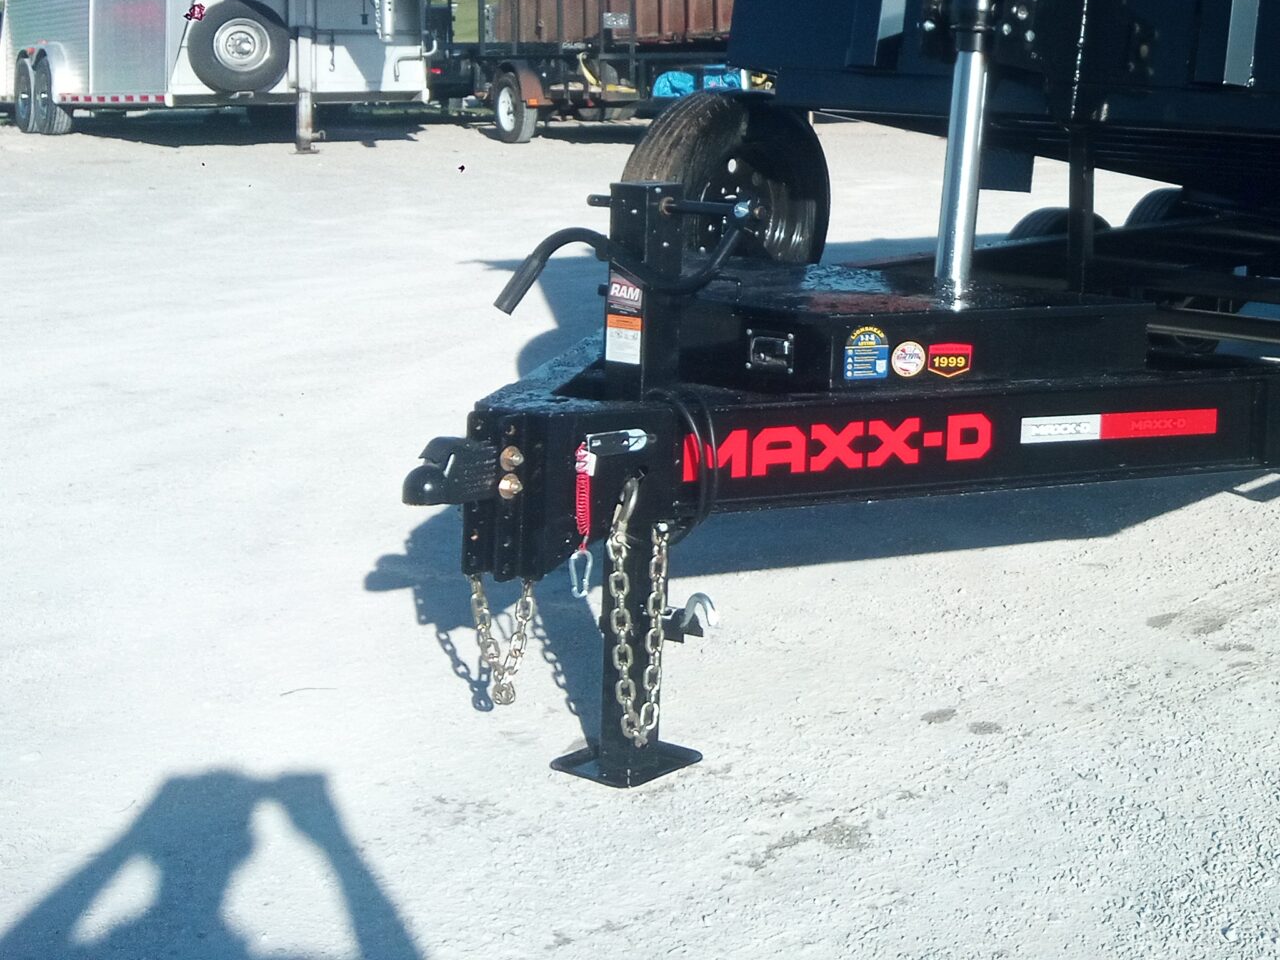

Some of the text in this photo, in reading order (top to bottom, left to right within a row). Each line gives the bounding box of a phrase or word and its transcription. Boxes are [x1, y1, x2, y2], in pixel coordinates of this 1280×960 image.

[610, 283, 641, 301] RAM
[933, 356, 966, 368] 1999
[1131, 418, 1187, 431] MAXX-D
[682, 413, 993, 482] MAXX-D
